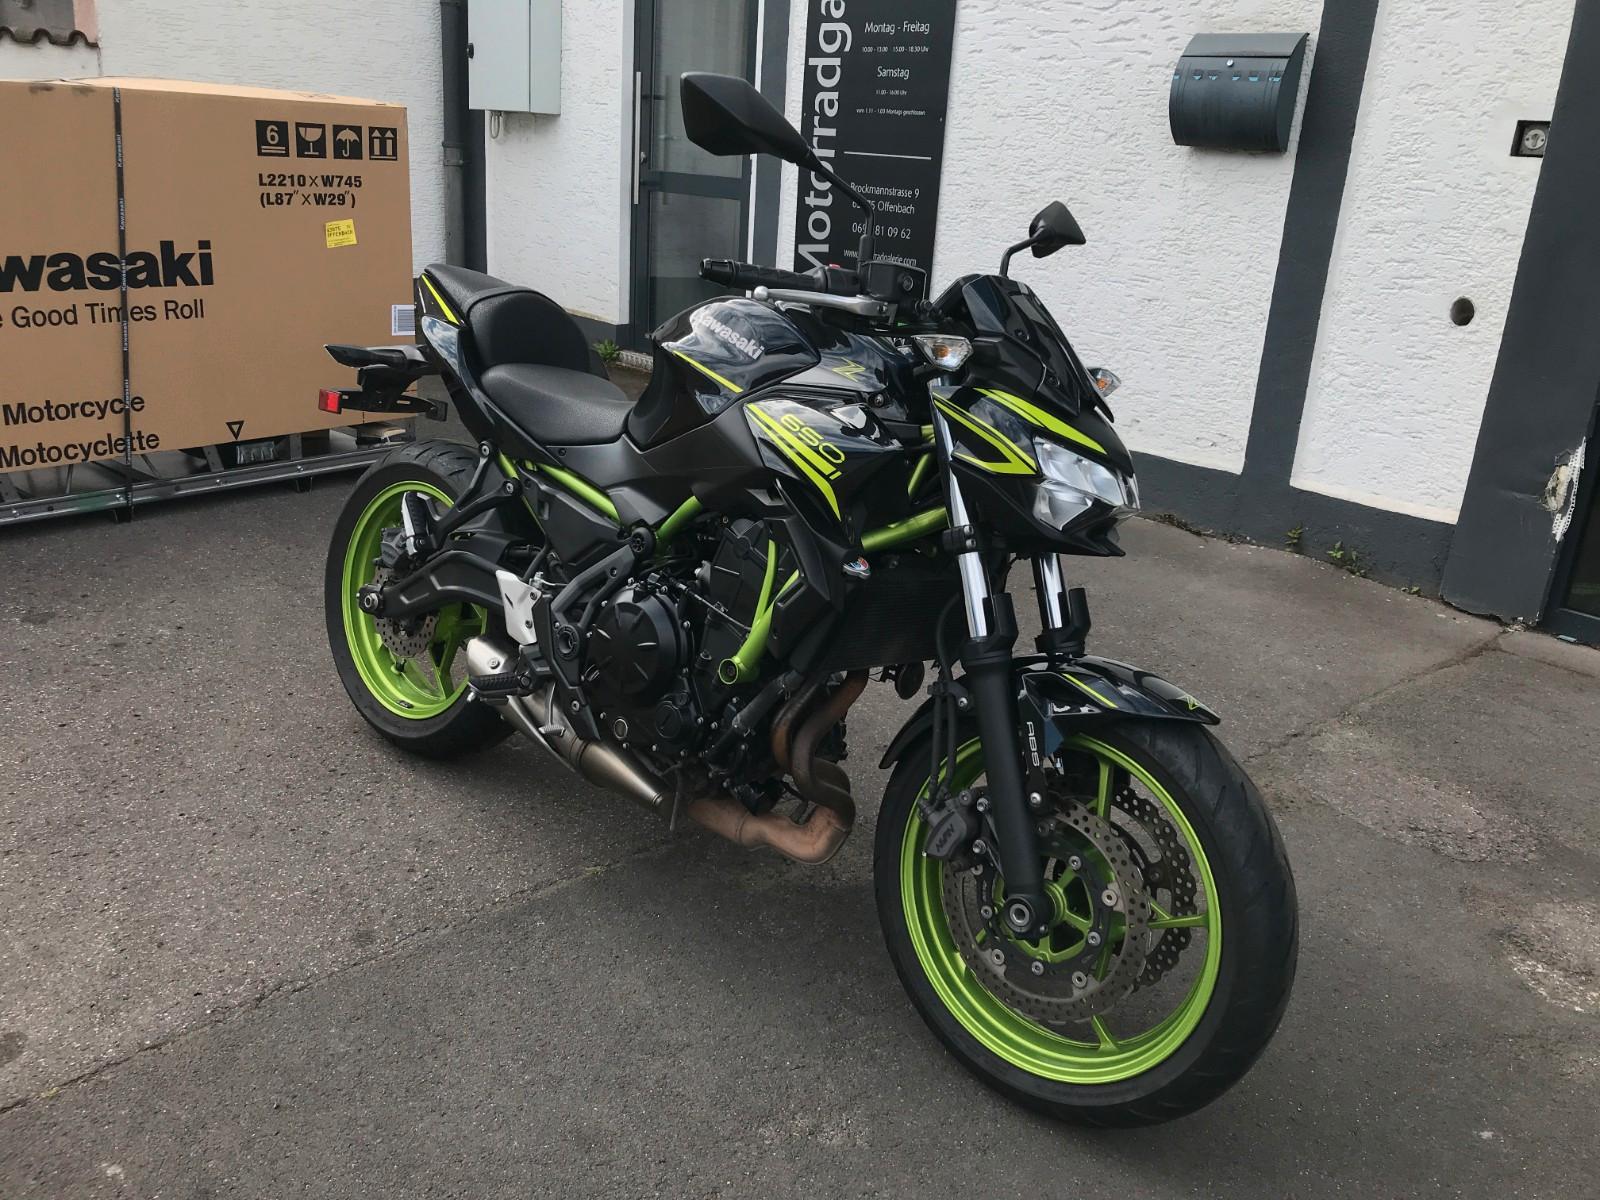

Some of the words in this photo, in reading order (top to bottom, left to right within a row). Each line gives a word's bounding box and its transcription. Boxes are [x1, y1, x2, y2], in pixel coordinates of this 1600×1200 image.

[864, 21, 896, 35] Montag
[902, 20, 930, 35] Freitag
[877, 65, 910, 80] Samstag
[914, 185, 920, 199] 9
[877, 200, 915, 214] Offenbach
[875, 224, 885, 237] 81
[887, 226, 899, 238] 09
[900, 228, 911, 240] 62
[12, 304, 78, 328] Good
[85, 302, 157, 324] Times
[164, 299, 204, 320] Roll
[692, 312, 765, 360] awasaki
[2, 396, 145, 426] Motorcyce
[780, 414, 846, 464] 650
[1026, 721, 1040, 767] ABS
